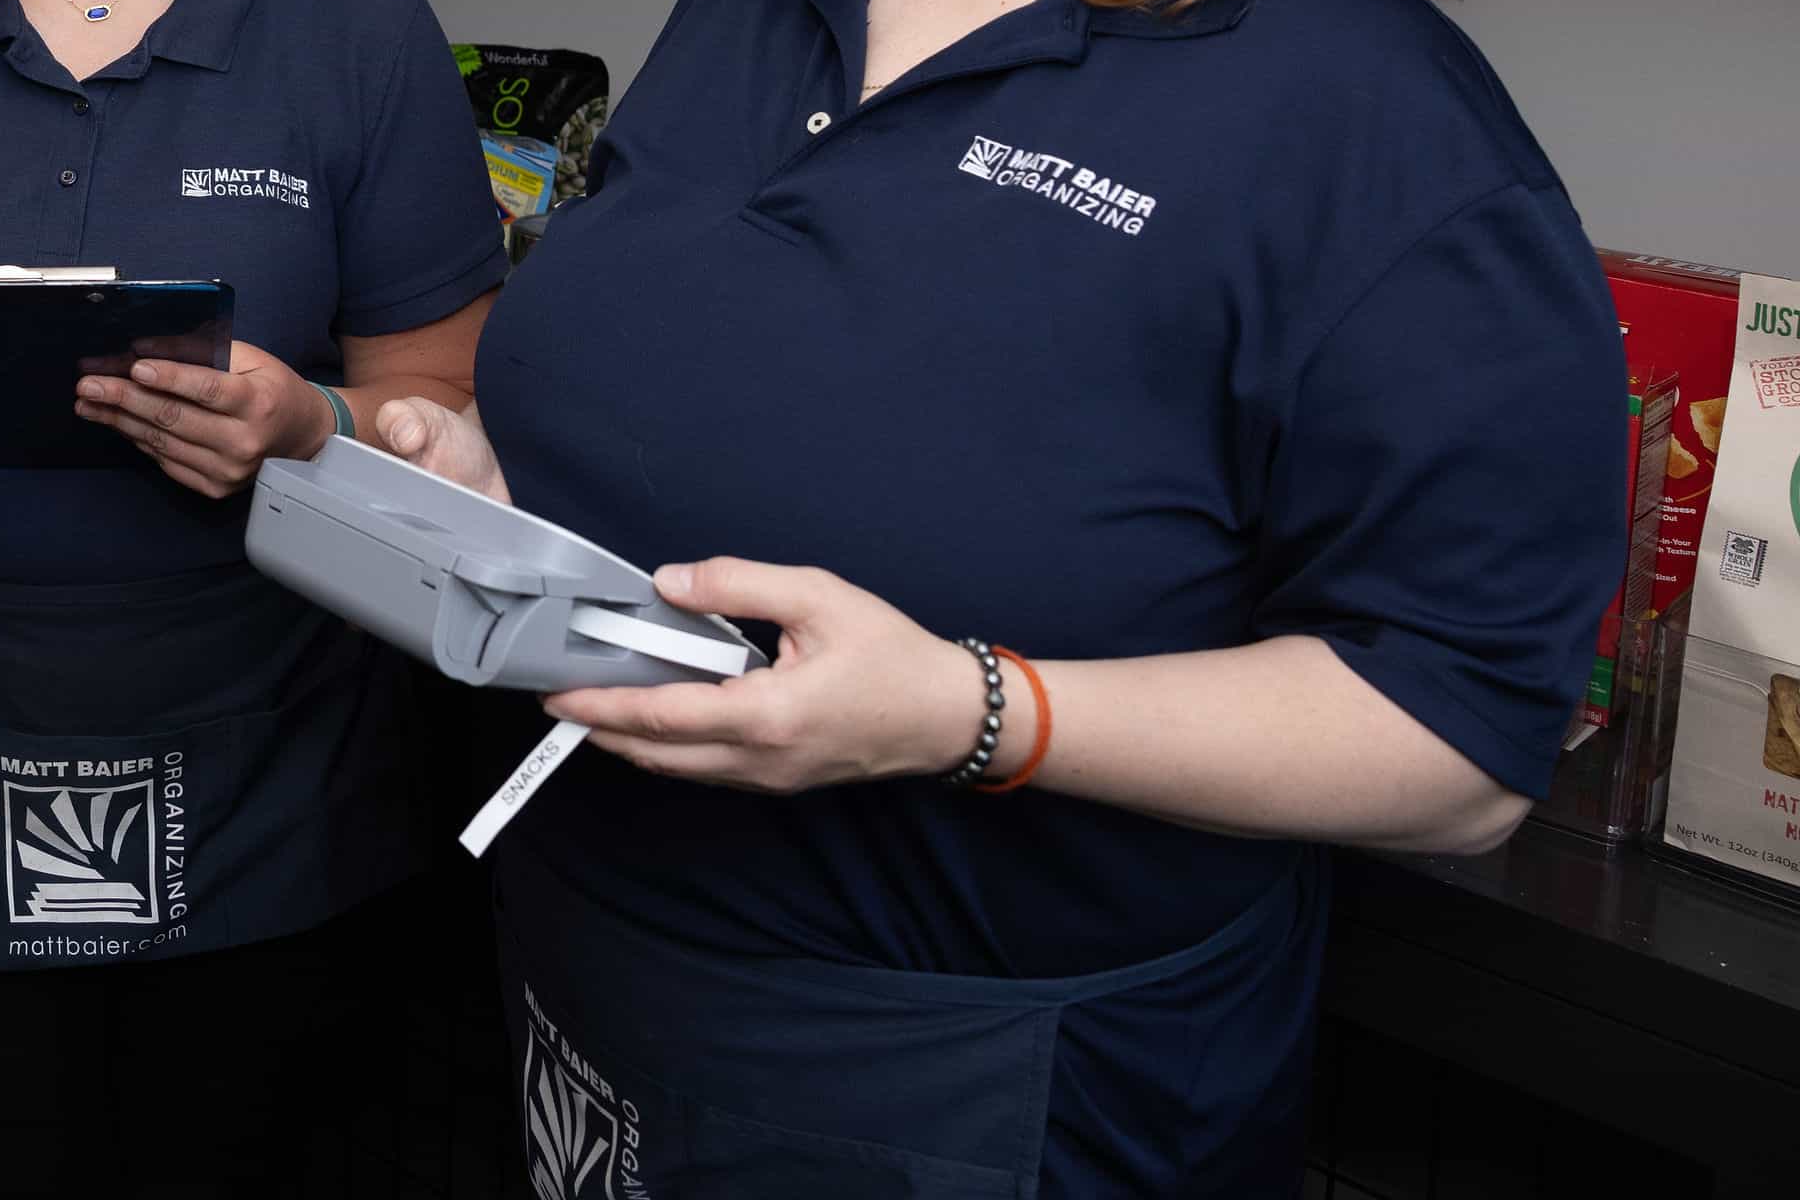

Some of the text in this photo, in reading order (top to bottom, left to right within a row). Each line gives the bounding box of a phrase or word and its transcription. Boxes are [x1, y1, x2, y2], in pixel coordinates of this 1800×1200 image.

[484, 52, 549, 66] Wonderful
[214, 167, 308, 194] MATT BAIER
[214, 183, 311, 209] ORGANIZING
[1008, 149, 1157, 218] MATT BAIER
[995, 169, 1145, 236] ORGANIZING
[0, 756, 154, 777] MATT BAIER
[500, 739, 561, 807] SNACKS
[163, 751, 188, 921] ORGANIZING
[1676, 824, 1697, 839] Net
[1728, 841, 1758, 858] 12oz
[8, 923, 188, 956] mattbaier.com
[523, 980, 616, 1104] MATT BAIER
